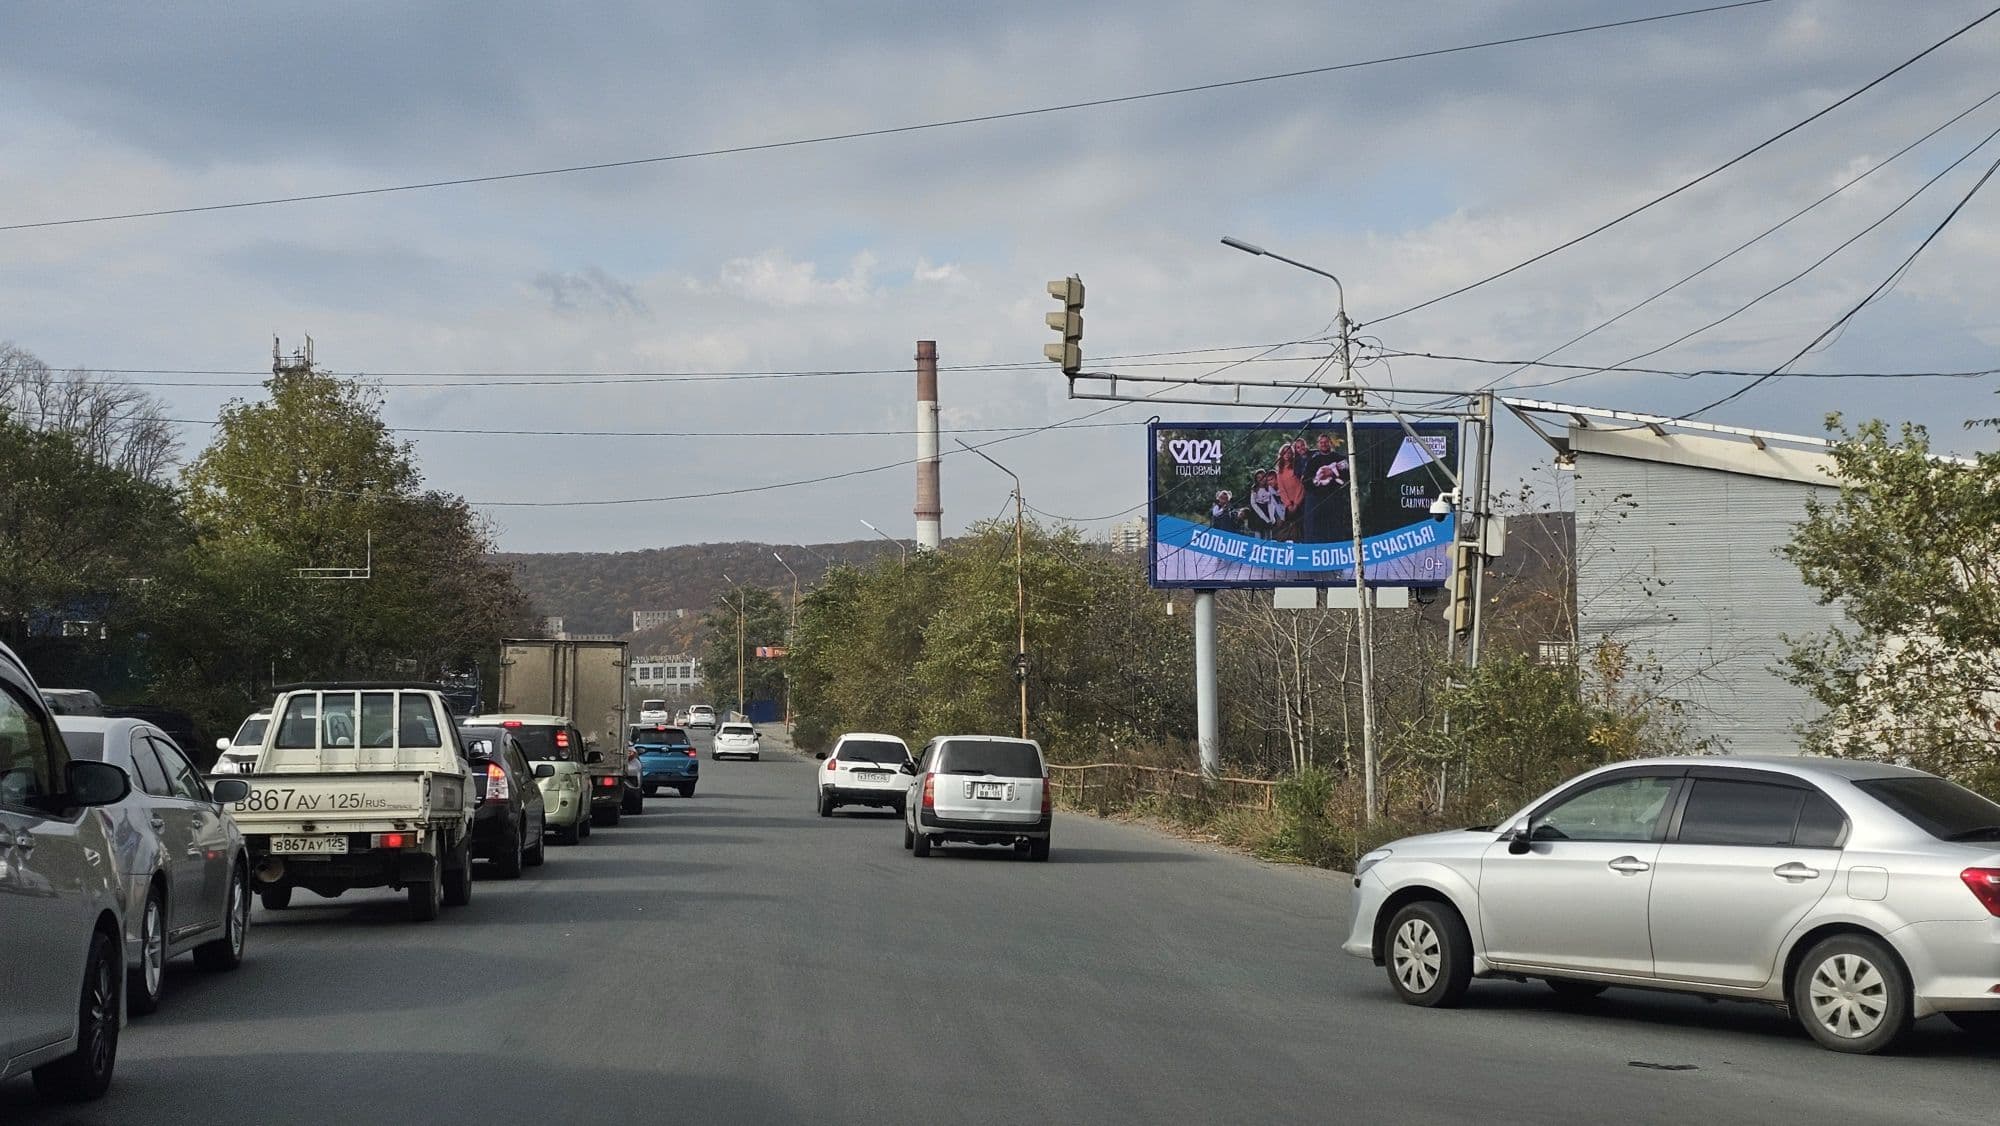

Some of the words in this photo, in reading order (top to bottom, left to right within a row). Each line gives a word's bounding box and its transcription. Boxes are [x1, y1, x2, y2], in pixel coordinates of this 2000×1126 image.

[1175, 440, 1222, 464] 2024
[1175, 465, 1192, 477] ГОД
[1192, 465, 1221, 476] СЕМЬИ
[1190, 529, 1249, 559] БОЛЬШЕ
[1248, 544, 1295, 566] ДЕТЕЙ
[1371, 525, 1436, 559] СЧАСТЬЯ!
[1425, 557, 1443, 571] 0+
